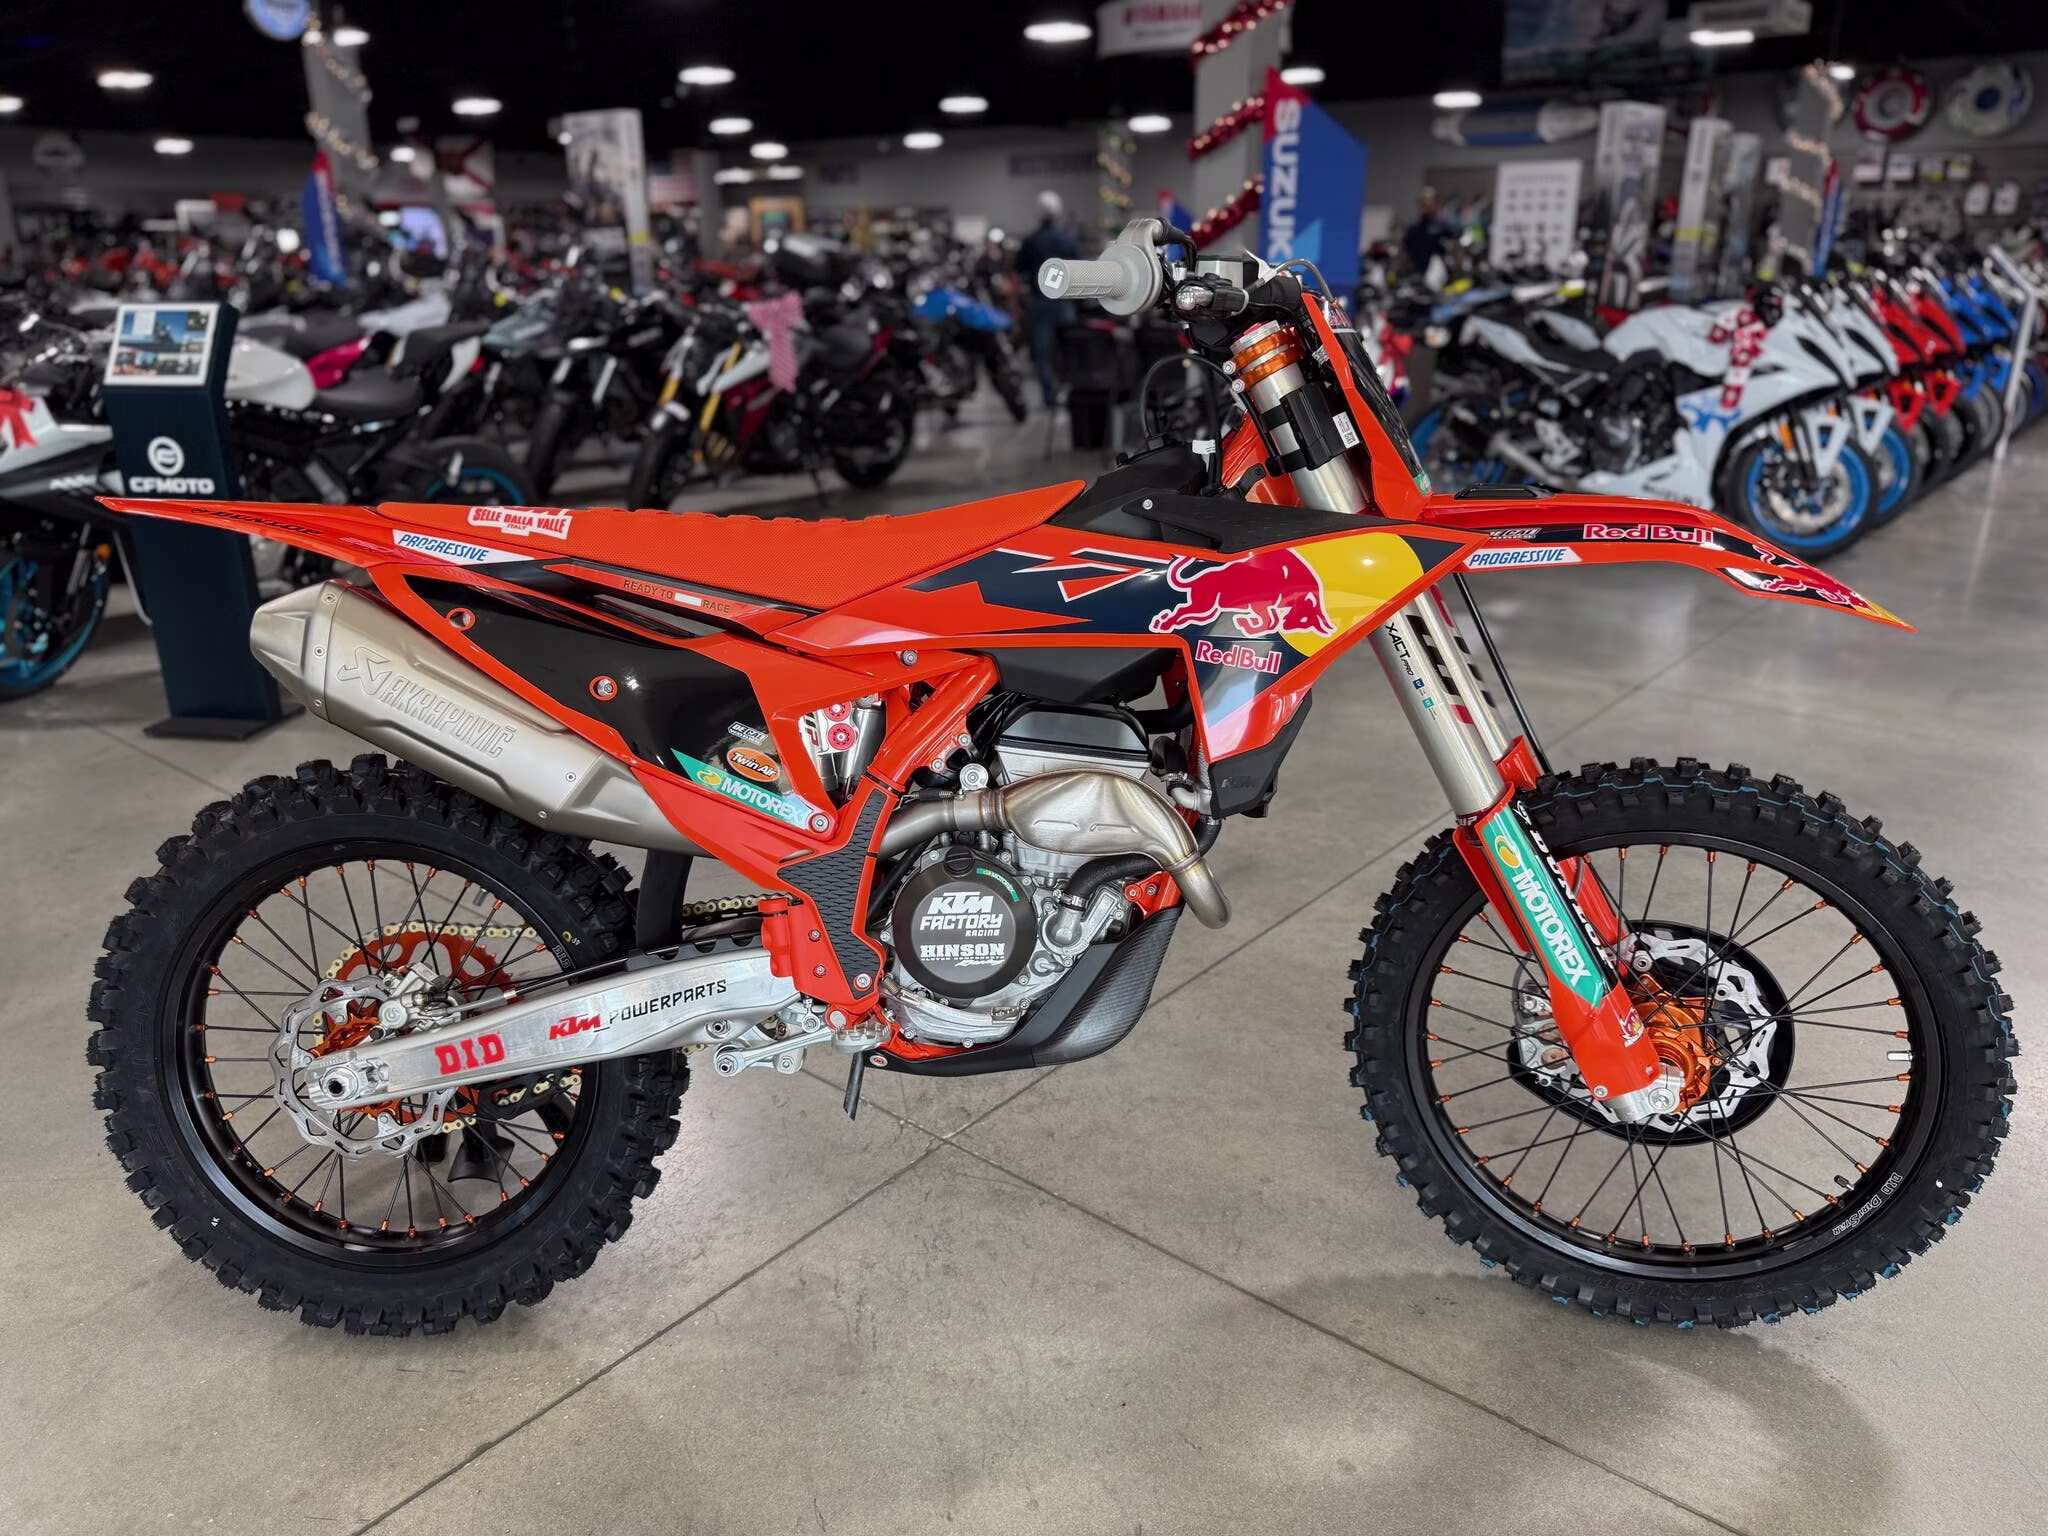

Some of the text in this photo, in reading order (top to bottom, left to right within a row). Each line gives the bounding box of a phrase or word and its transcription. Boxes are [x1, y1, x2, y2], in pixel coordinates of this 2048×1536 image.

[1267, 97, 1303, 266] SUZUK
[128, 476, 215, 495] CFMOTO
[473, 507, 567, 534] SELLE DALLA VALLE
[507, 523, 527, 531] ITALY
[1582, 523, 1713, 543] Red Bull
[398, 533, 489, 562] PROGRESSIVE
[1468, 548, 1567, 566] PROGRESSIVE
[623, 579, 731, 613] READY TO RACE
[1195, 640, 1282, 674] Red Bull
[731, 752, 778, 777] Twin Air
[721, 778, 804, 824] MOTOREX
[927, 891, 994, 914] KTM
[920, 914, 1003, 930] FACTORY
[965, 929, 1000, 937] RACING
[1511, 868, 1592, 986] MOTOREX
[920, 943, 1005, 957] HINSON
[549, 1013, 601, 1040] KTM
